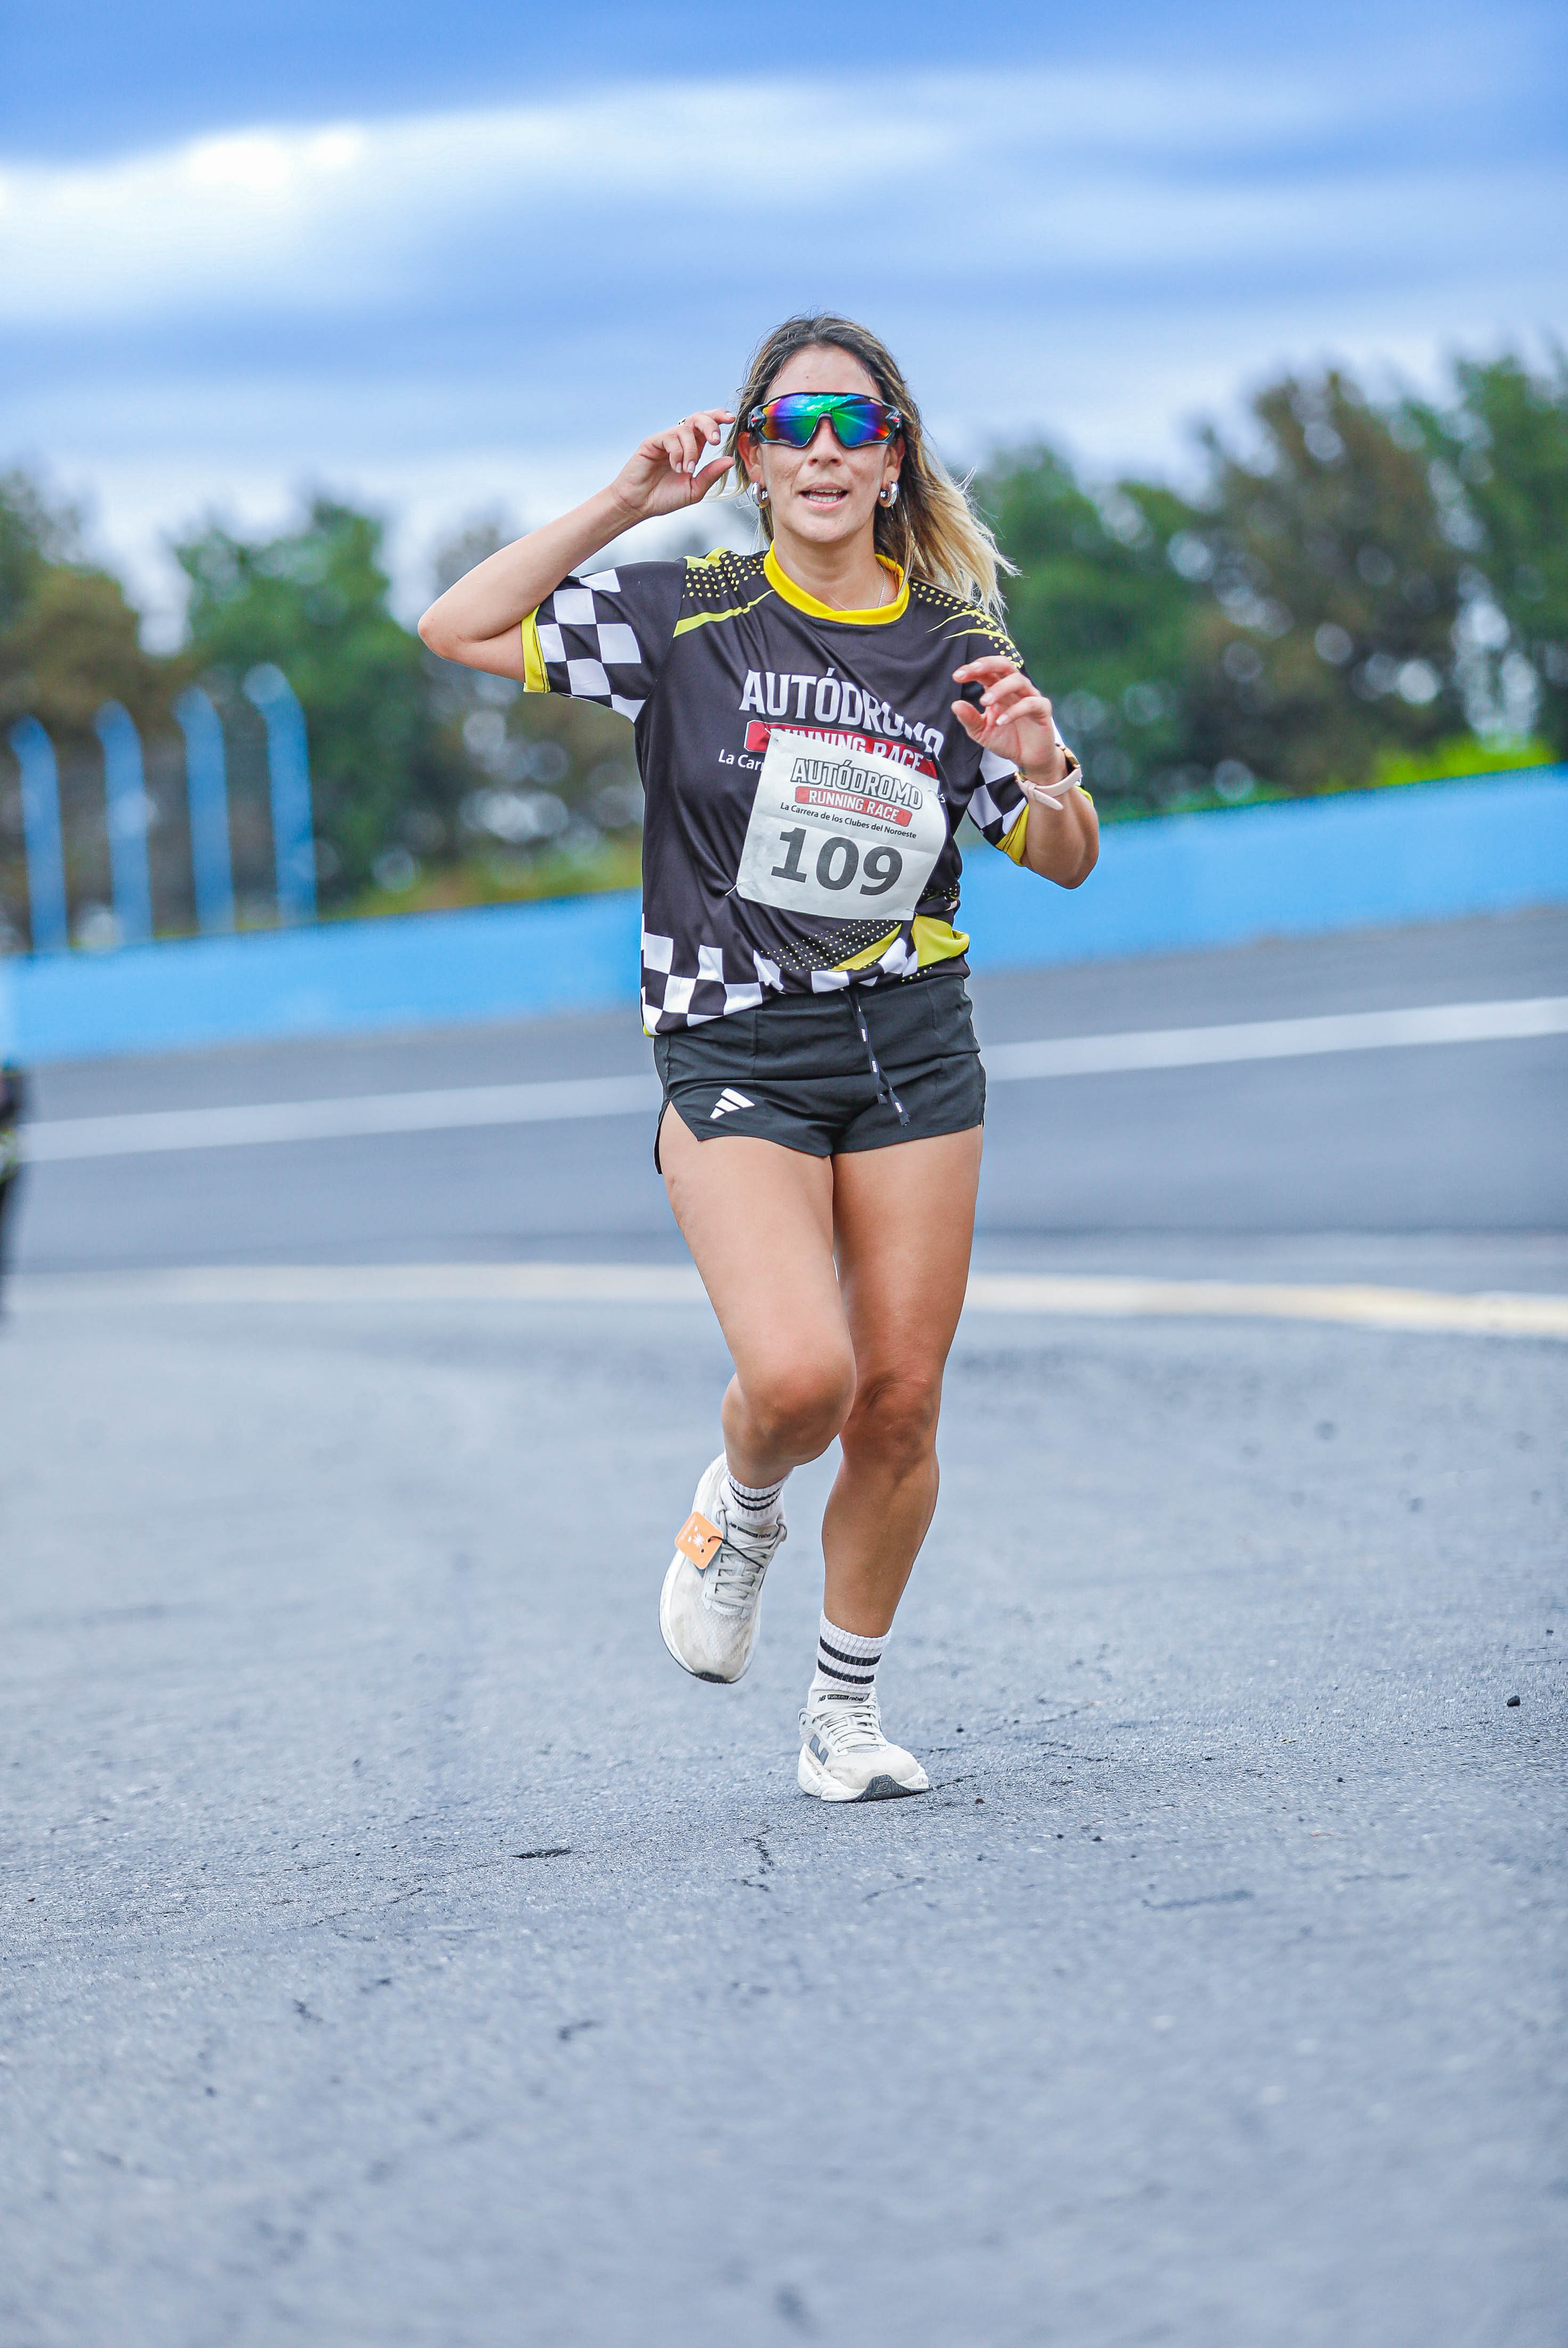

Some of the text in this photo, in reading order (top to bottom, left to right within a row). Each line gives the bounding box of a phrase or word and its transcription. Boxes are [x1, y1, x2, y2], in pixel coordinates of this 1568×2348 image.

[718, 749, 735, 765] La
[791, 758, 923, 810] AUTÓDROMO
[781, 802, 917, 839] La Carrera de los Clubes del Noroeste
[808, 790, 899, 822] RUNNING RACE
[771, 827, 903, 896] 109
